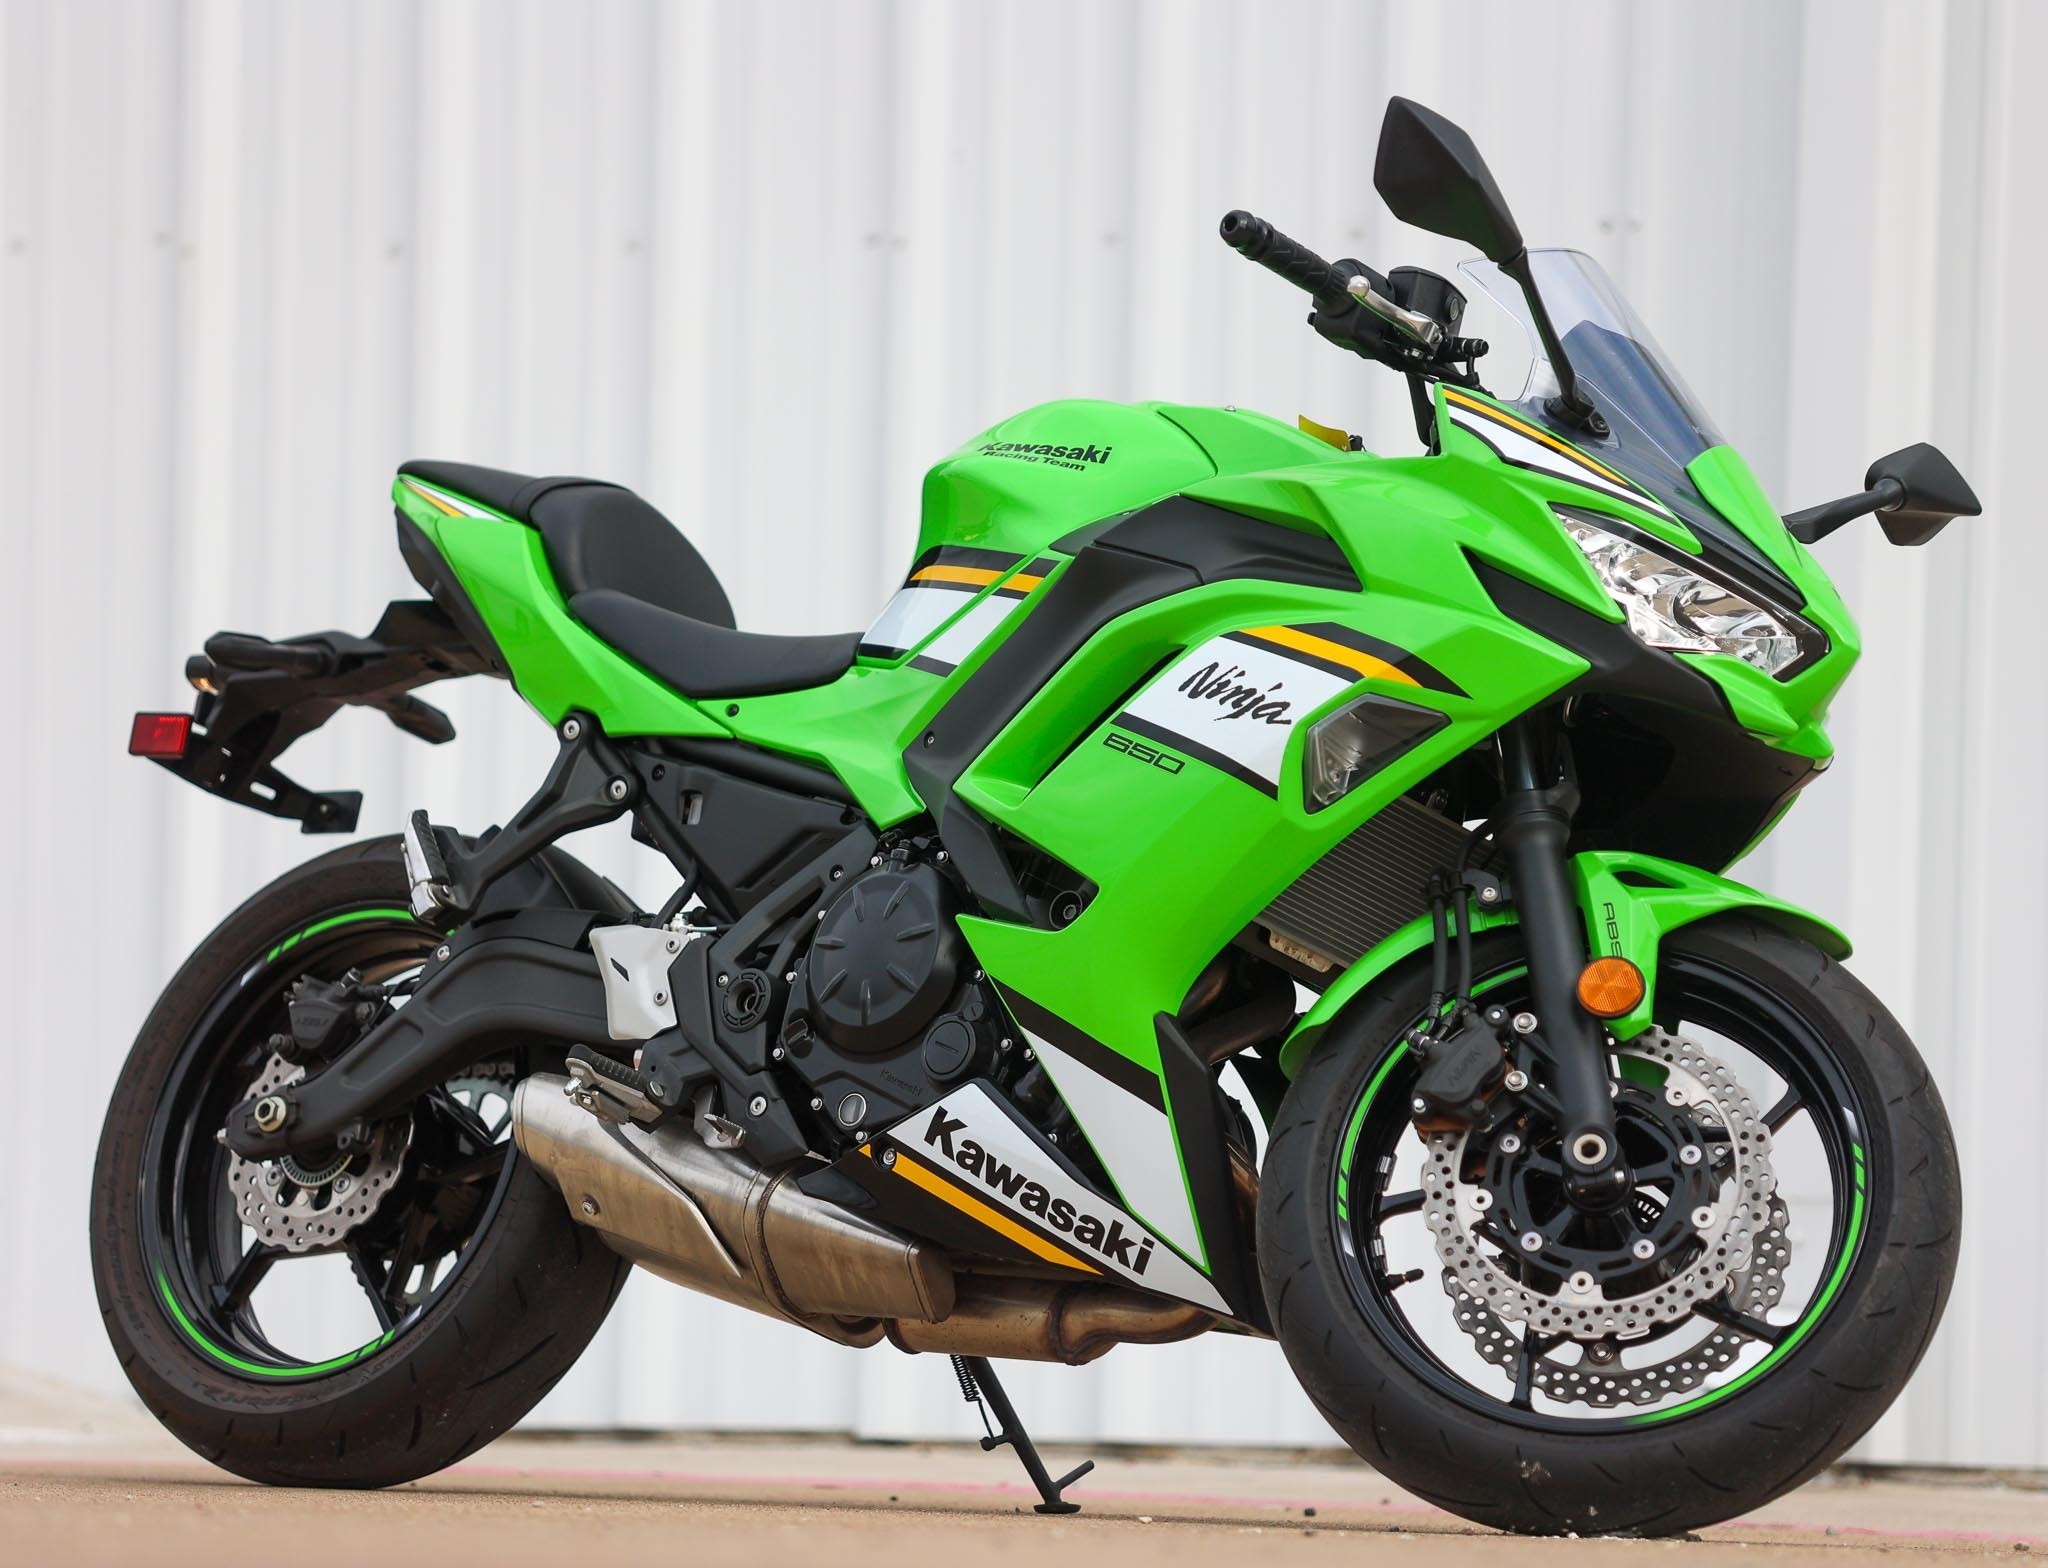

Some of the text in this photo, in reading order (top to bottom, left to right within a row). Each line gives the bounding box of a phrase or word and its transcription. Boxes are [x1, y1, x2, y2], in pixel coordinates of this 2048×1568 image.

[977, 441, 1112, 464] Kawasaki
[983, 451, 1086, 471] Racing Team
[1178, 661, 1292, 725] Ninja
[1103, 732, 1186, 775] 650
[1603, 902, 1623, 957] ABS
[923, 1105, 1155, 1276] Kawasaki
